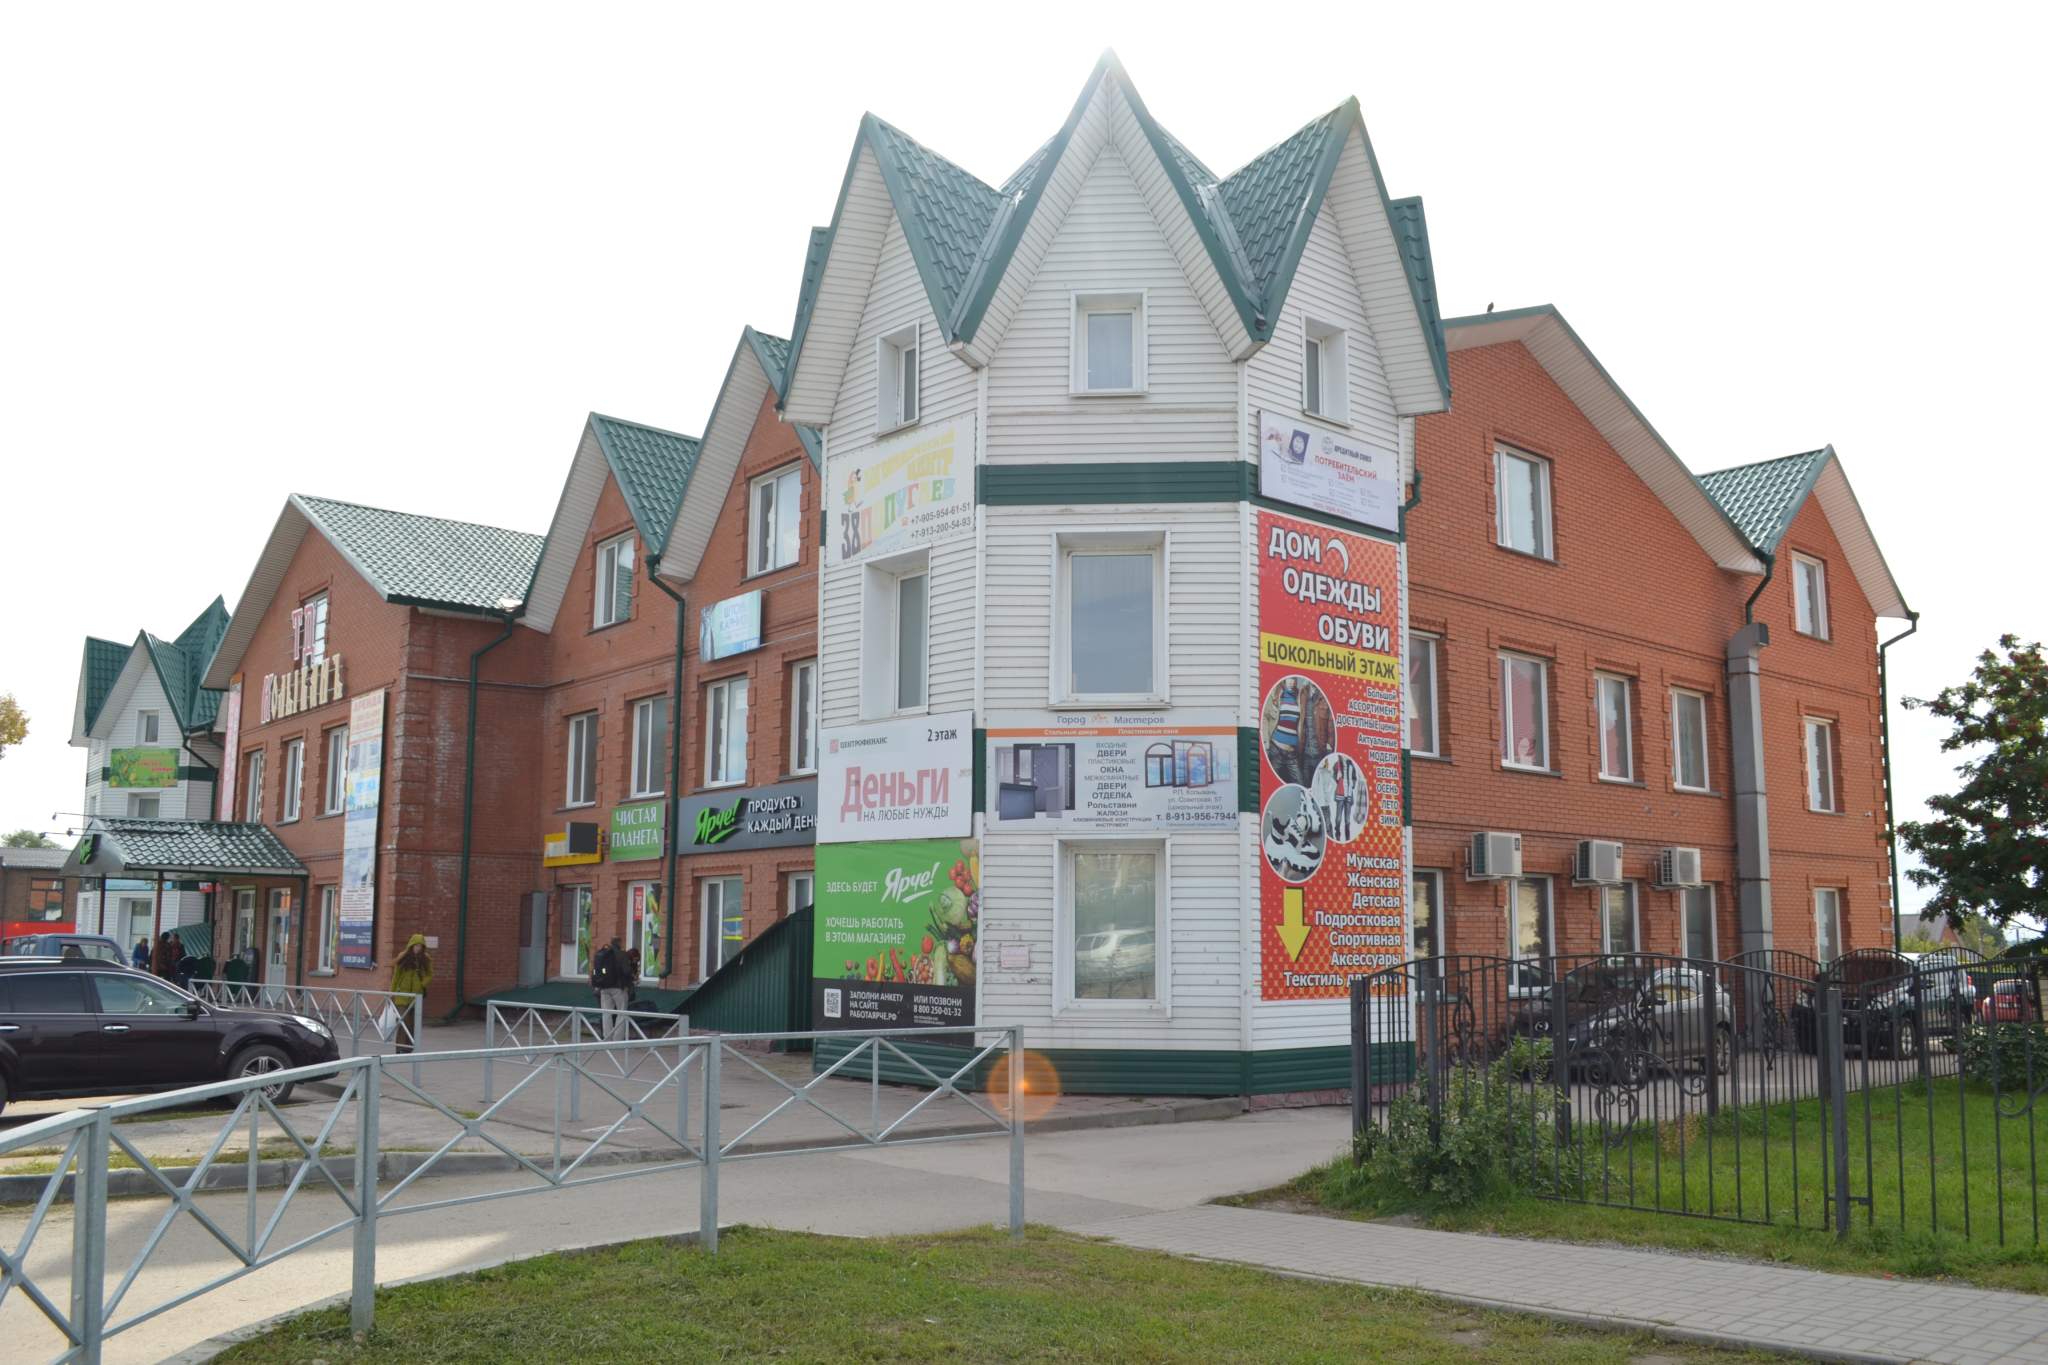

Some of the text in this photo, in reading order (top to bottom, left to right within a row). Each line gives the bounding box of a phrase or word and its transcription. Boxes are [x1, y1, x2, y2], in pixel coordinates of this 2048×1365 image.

[1315, 455, 1377, 480] ПОТРЕБИТЕЛЬСКИЙ
[1268, 525, 1322, 564] ДОМ
[1282, 566, 1382, 616] ОДЕЖДЫ
[1318, 613, 1391, 653] ОБУВИ
[1267, 639, 1396, 680] ЦОКОЛЬНЫЙ ЭТАЖ
[1367, 687, 1397, 701] Большой
[1349, 701, 1397, 716] АССОРТИМЕНТ
[1057, 716, 1165, 725] Город Мастеров
[1336, 714, 1379, 730] ДОСТУПНЫЕ
[927, 728, 957, 742] 2 этаж
[1358, 733, 1398, 749] Актуальные
[1096, 750, 1127, 758] ДВЕРИ
[1369, 751, 1398, 764] МОДЕЛИ
[1099, 766, 1124, 774] ОКНА
[1376, 767, 1399, 779] ВЕСНА
[1096, 782, 1127, 790] ДВЕРИ
[1376, 782, 1399, 794] ОСЕНЬ
[840, 766, 949, 823] Деньги
[1092, 792, 1133, 800] ОТДЕЛКА
[1087, 801, 1137, 809] Рольставни
[1381, 799, 1399, 810] ЛЕТО
[615, 806, 657, 826] ЧИСТАЯ
[692, 795, 804, 845] Ярче! ПРОДУКТЫ
[863, 806, 949, 822] НА ЛЮБЫЕ НУЖДЫ
[1166, 812, 1237, 821] 8-913-956-7944
[1380, 815, 1399, 825] ЗИМА
[747, 812, 792, 834] КАЖДЫЙ
[611, 828, 659, 848] ПЛАНЕТА
[1347, 853, 1400, 871] Мужская
[826, 862, 941, 903] ЗДЕСЬ БУДЕТ Ярче!
[1347, 872, 1400, 889] Женская
[1352, 892, 1400, 909] Детская
[826, 917, 904, 929] ХОЧЕШЬ РАБОТАТЬ
[1315, 911, 1401, 930] Подростковая
[826, 932, 906, 944] В ЭТОМ МАГАЗИНЕ?
[1329, 931, 1401, 949] Спортивная
[1331, 951, 1401, 969] Аксессуары
[1284, 971, 1344, 988] Текстиль
[850, 990, 904, 1002] ЗАПОЛНИ АНКЕТУ
[914, 995, 962, 1007] ИЛИ ПОЗВОНИ
[850, 1000, 879, 1010] НА САЙТЕ
[913, 1005, 918, 1013] 8
[918, 1005, 930, 1014] 800
[850, 1010, 898, 1021] РАБОТАЯРЧЕ.РФ
